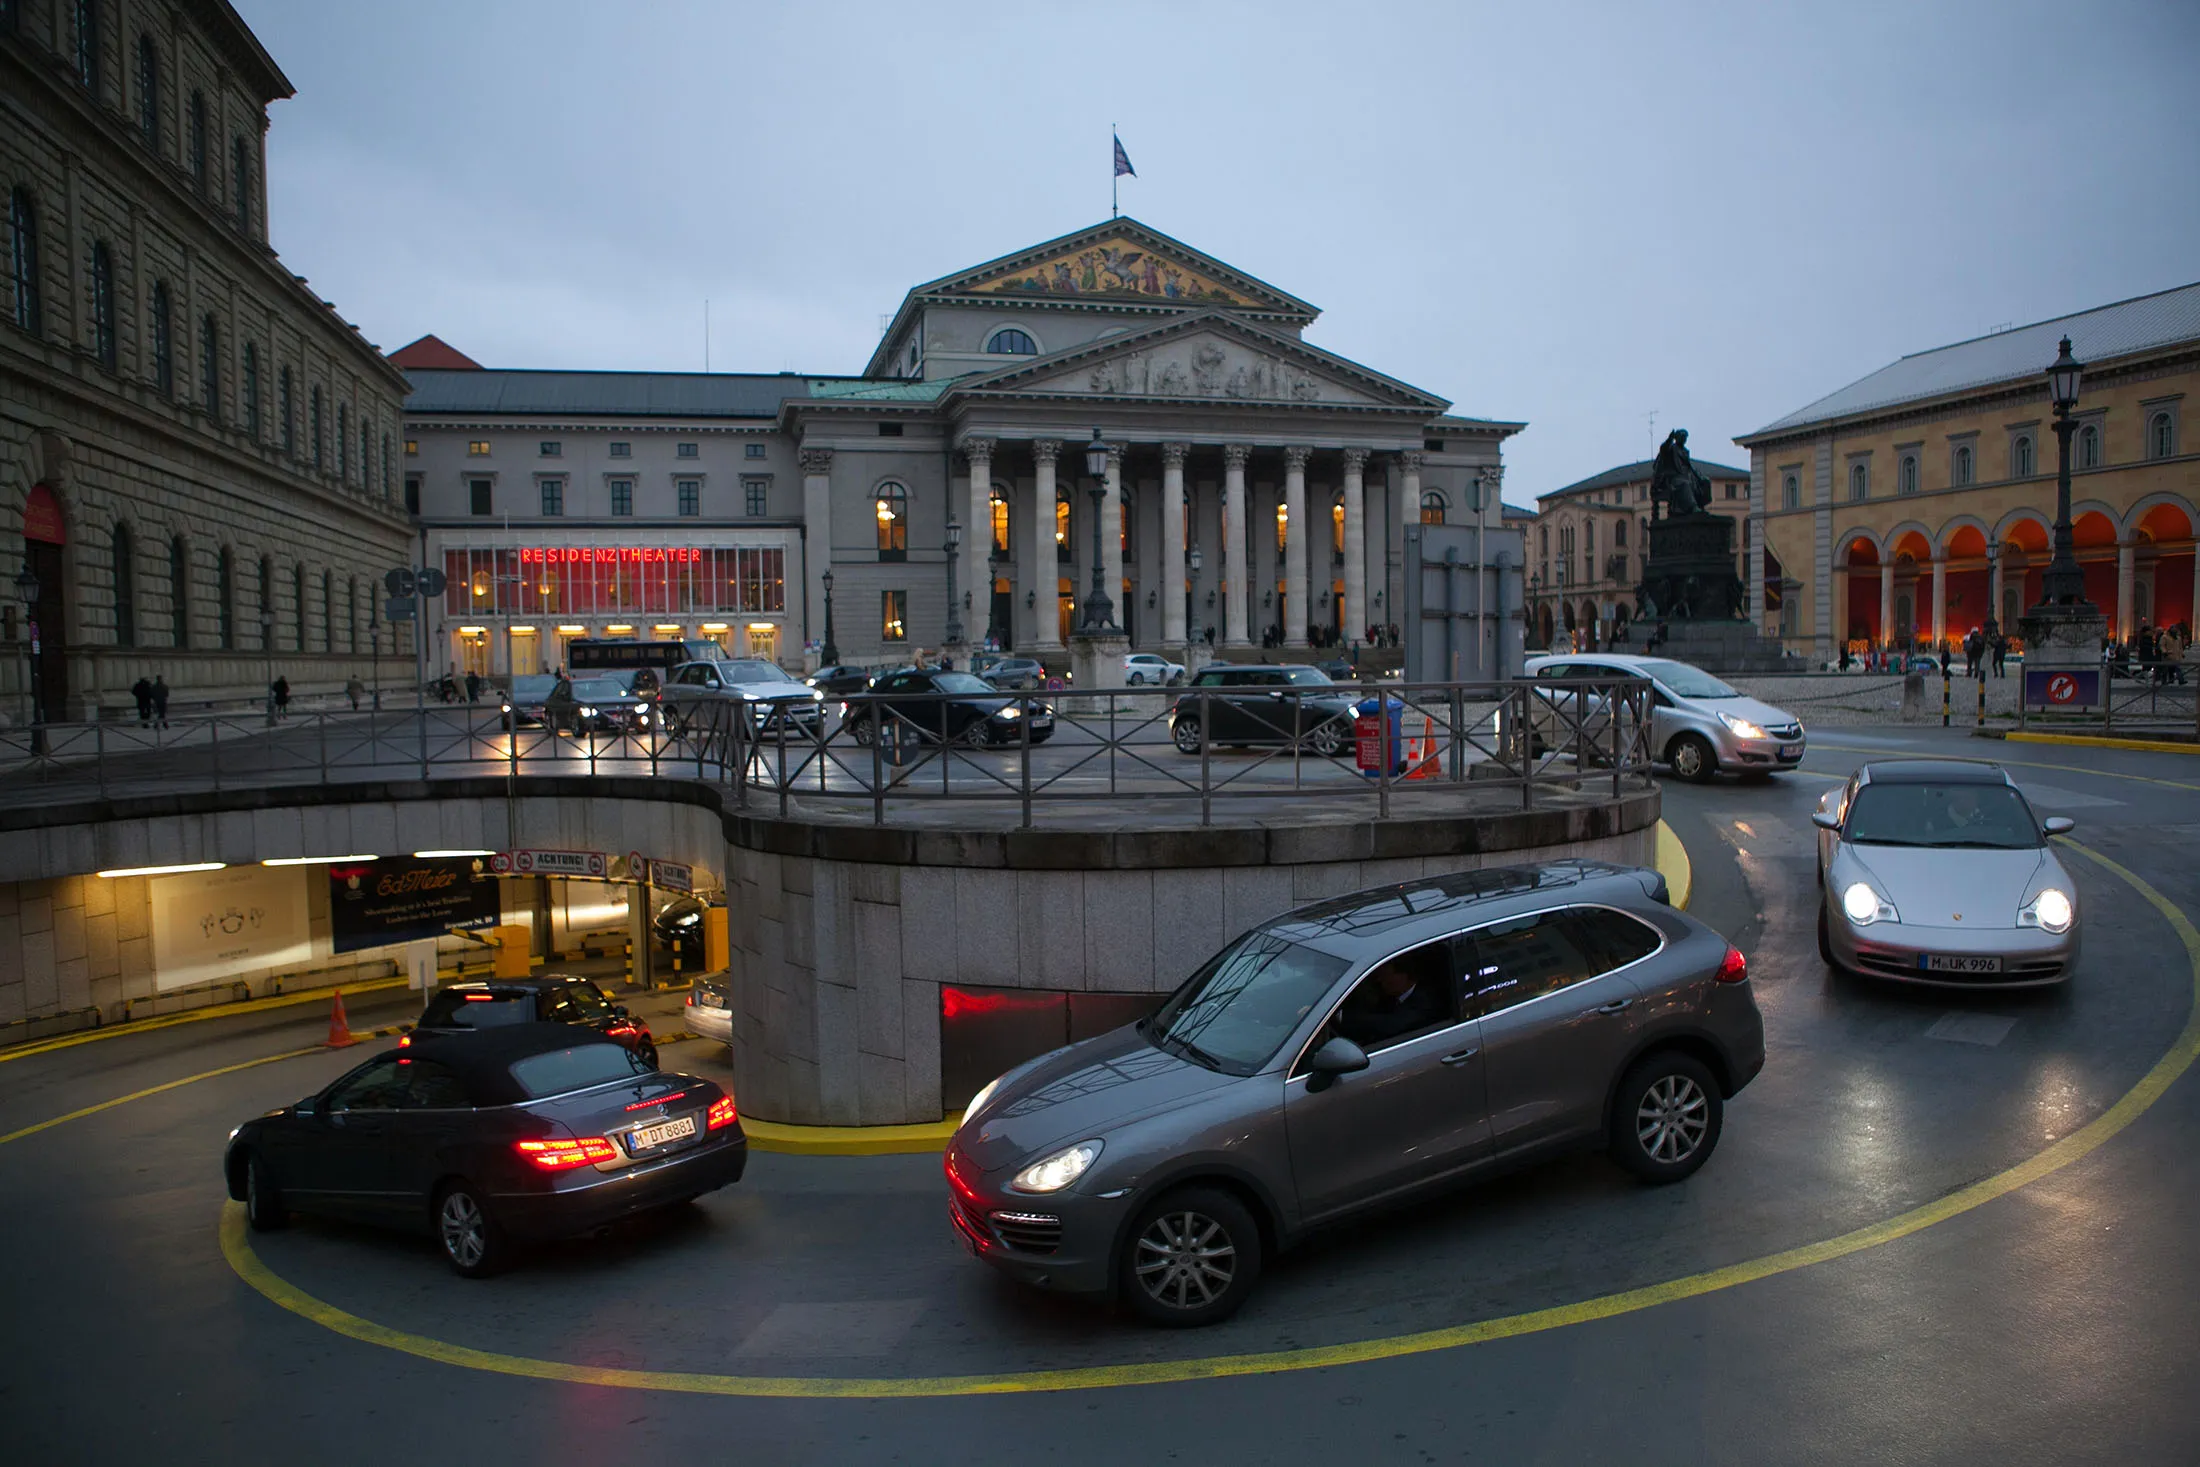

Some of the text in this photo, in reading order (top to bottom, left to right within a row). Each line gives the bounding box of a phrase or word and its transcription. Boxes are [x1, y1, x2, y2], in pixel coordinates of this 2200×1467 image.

[521, 548, 701, 562] RESIDENZTHEATER
[537, 853, 584, 865] ACHTUNG!
[1931, 957, 1995, 971] M UK 996
[634, 1120, 694, 1147] M DT 8881
